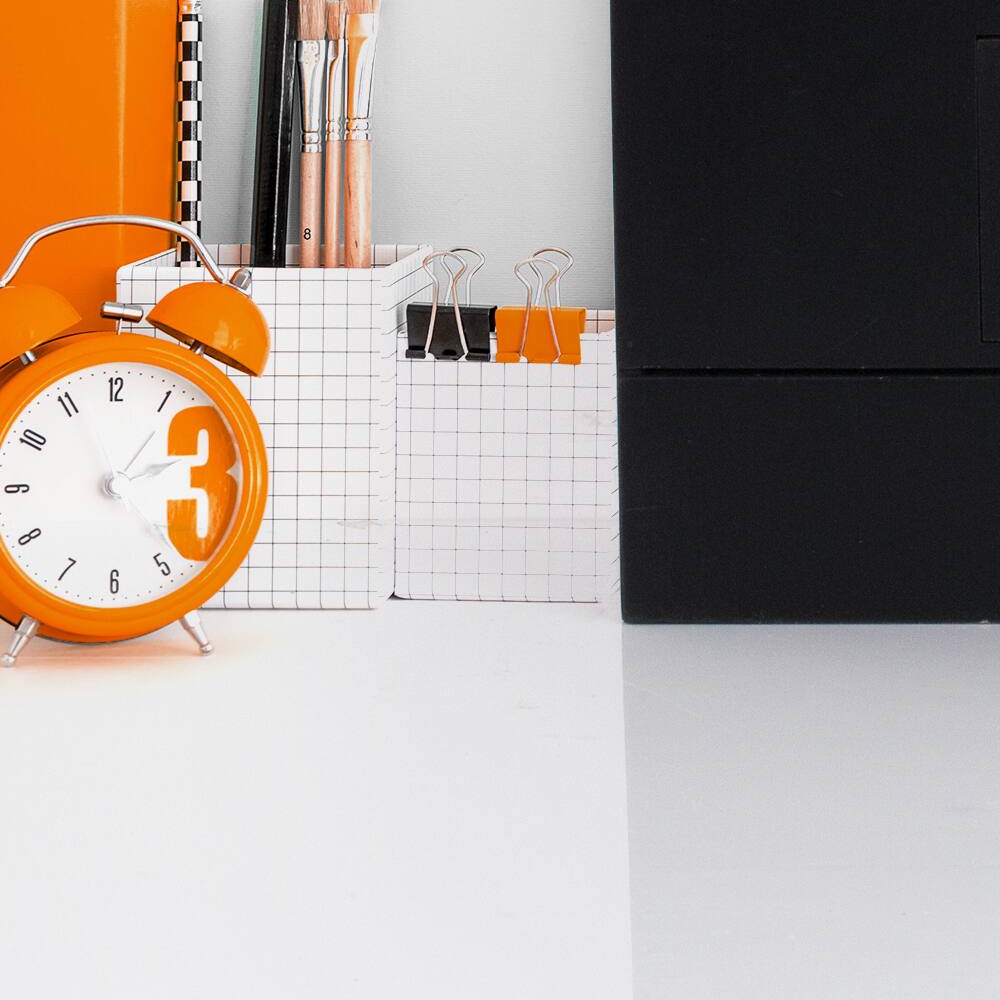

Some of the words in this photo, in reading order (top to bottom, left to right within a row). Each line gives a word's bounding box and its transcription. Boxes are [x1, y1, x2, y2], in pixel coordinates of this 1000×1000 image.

[303, 227, 312, 240] 8
[108, 377, 124, 402] 12
[157, 390, 172, 413] 1
[57, 391, 79, 418] 11
[19, 428, 47, 452] 10
[4, 483, 30, 494] 9
[166, 405, 242, 562] 3
[17, 527, 42, 546] 8
[57, 557, 77, 581] 7
[152, 552, 171, 577] 5
[109, 569, 120, 594] 6
